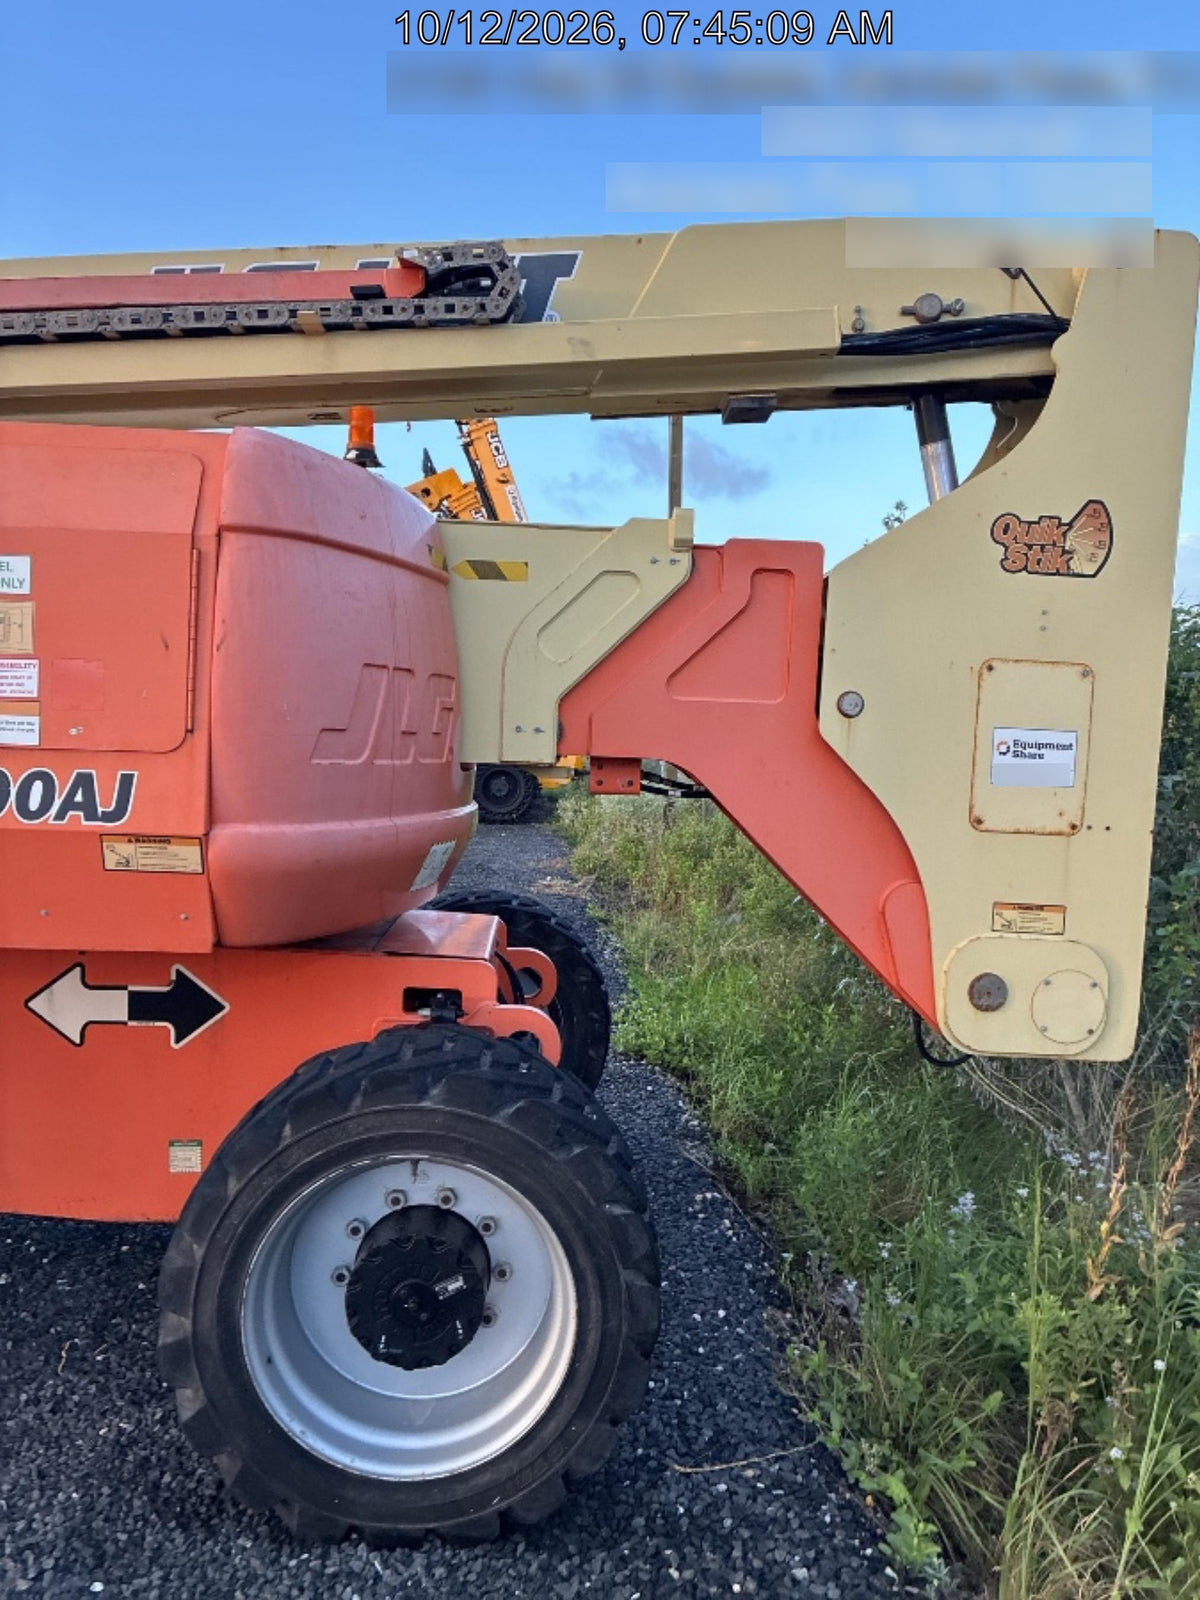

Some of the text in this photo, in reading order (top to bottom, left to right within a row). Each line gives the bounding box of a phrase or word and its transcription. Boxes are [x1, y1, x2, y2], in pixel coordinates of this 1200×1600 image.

[487, 431, 508, 469] JCB
[1012, 738, 1075, 752] Equipment
[1011, 749, 1045, 760] Share
